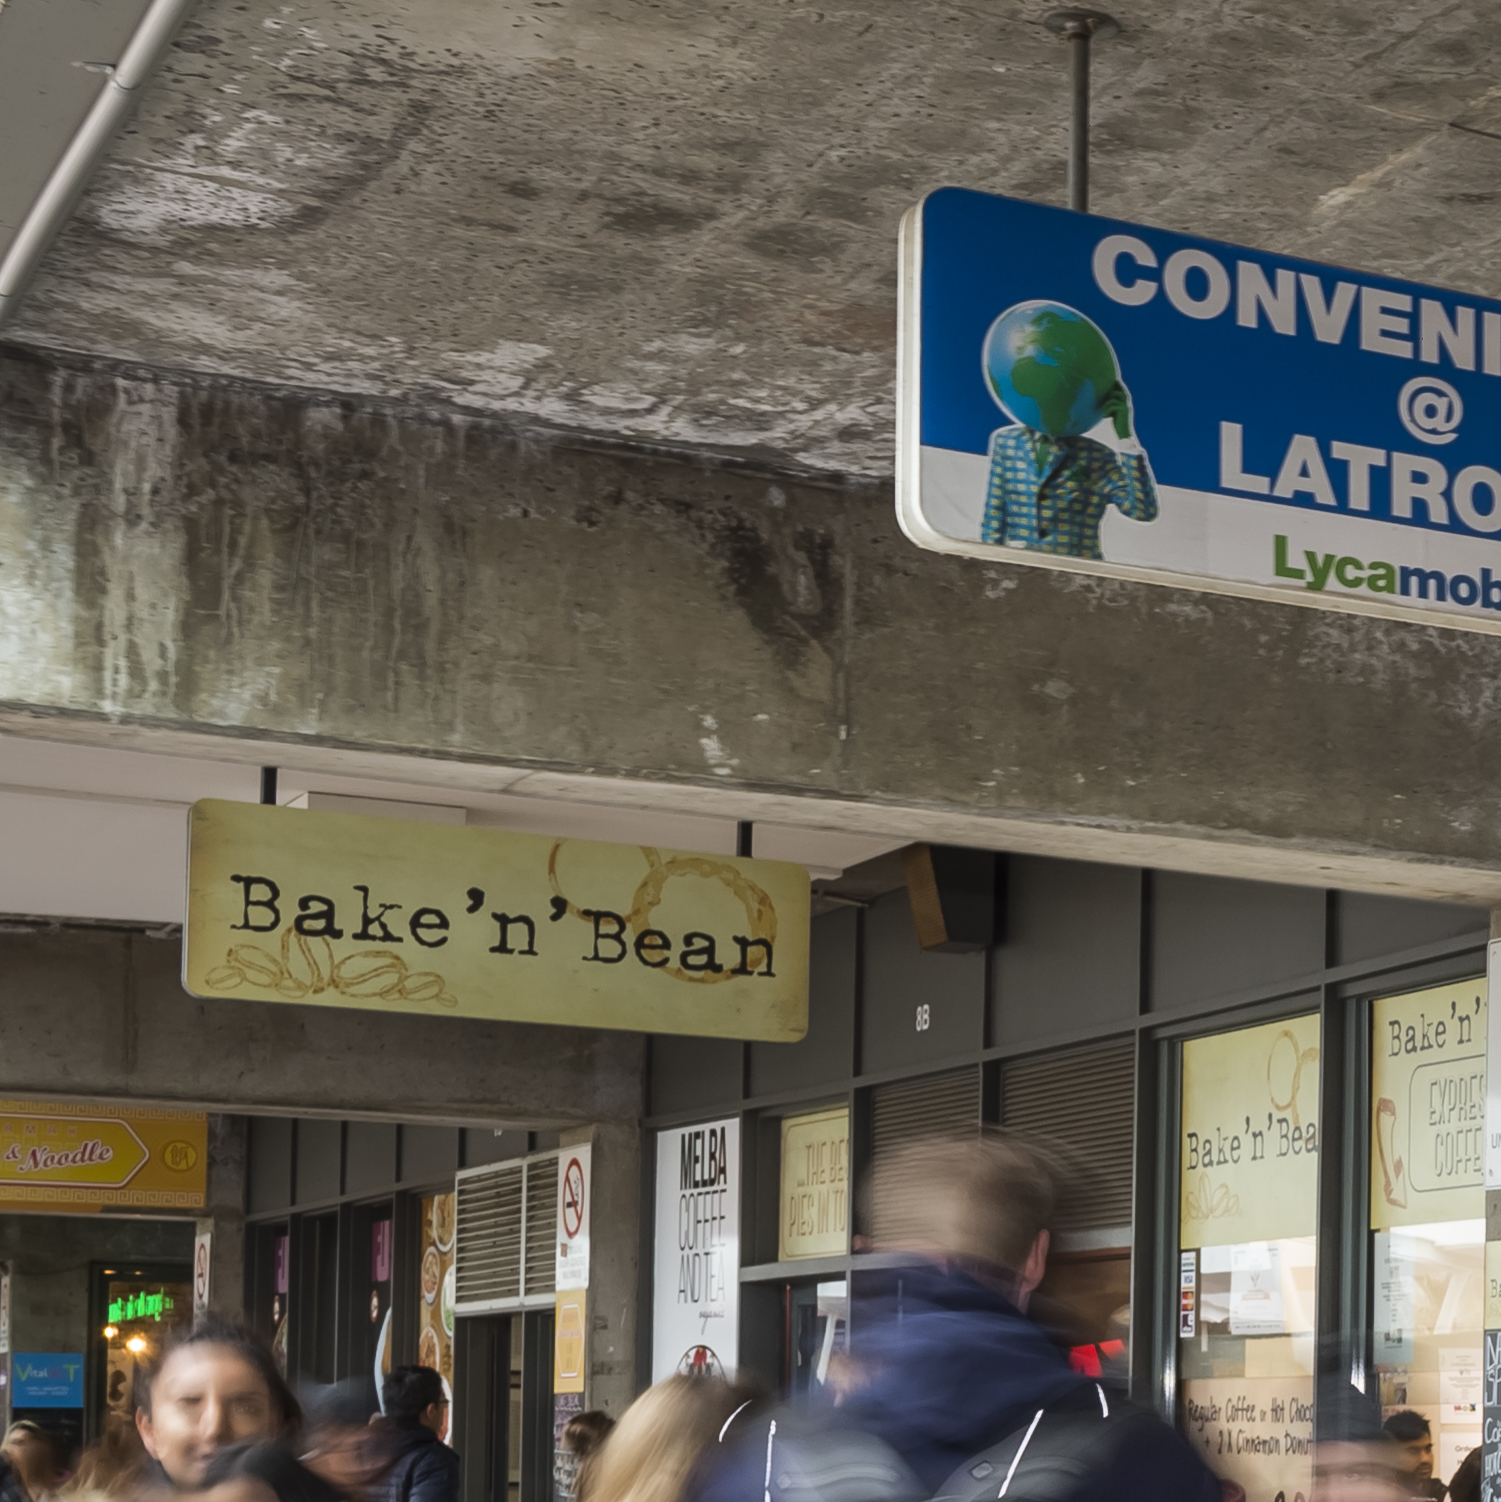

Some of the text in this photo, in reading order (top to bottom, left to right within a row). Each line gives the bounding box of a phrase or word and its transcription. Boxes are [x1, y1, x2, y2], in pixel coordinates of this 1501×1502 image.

[1399, 376, 1464, 445] @
[230, 873, 776, 979] Bake'n'Bean
[915, 1004, 930, 1032] 8B
[18, 1139, 113, 1172] Noodle
[680, 1126, 727, 1190] MELBA
[1187, 1112, 1318, 1170] Bake'n'Bea
[678, 1189, 727, 1250] COFFEE
[678, 1251, 725, 1304] AND TEA
[1188, 1396, 1256, 1431] Regular Coffee
